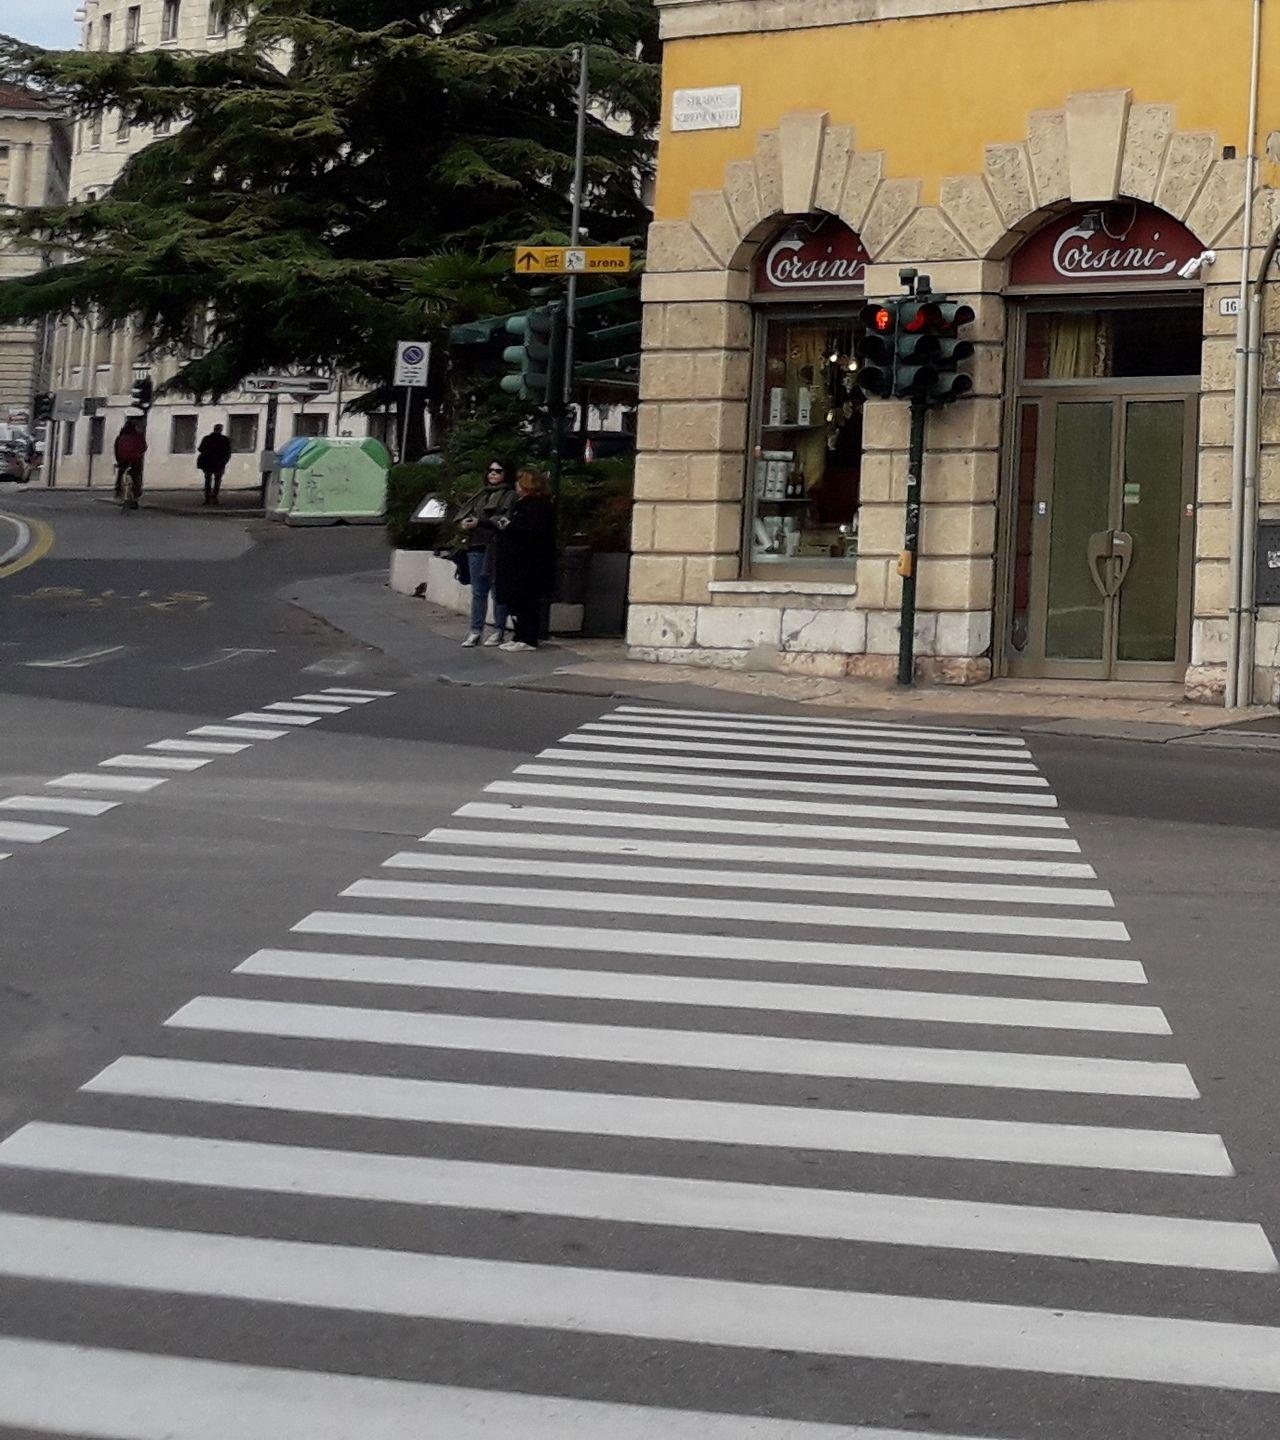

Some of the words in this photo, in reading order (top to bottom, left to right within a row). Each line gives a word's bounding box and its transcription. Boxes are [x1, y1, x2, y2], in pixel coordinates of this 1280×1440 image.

[589, 259, 624, 268] arena
[766, 240, 865, 287] Corsini
[1054, 225, 1176, 277] Corsini
